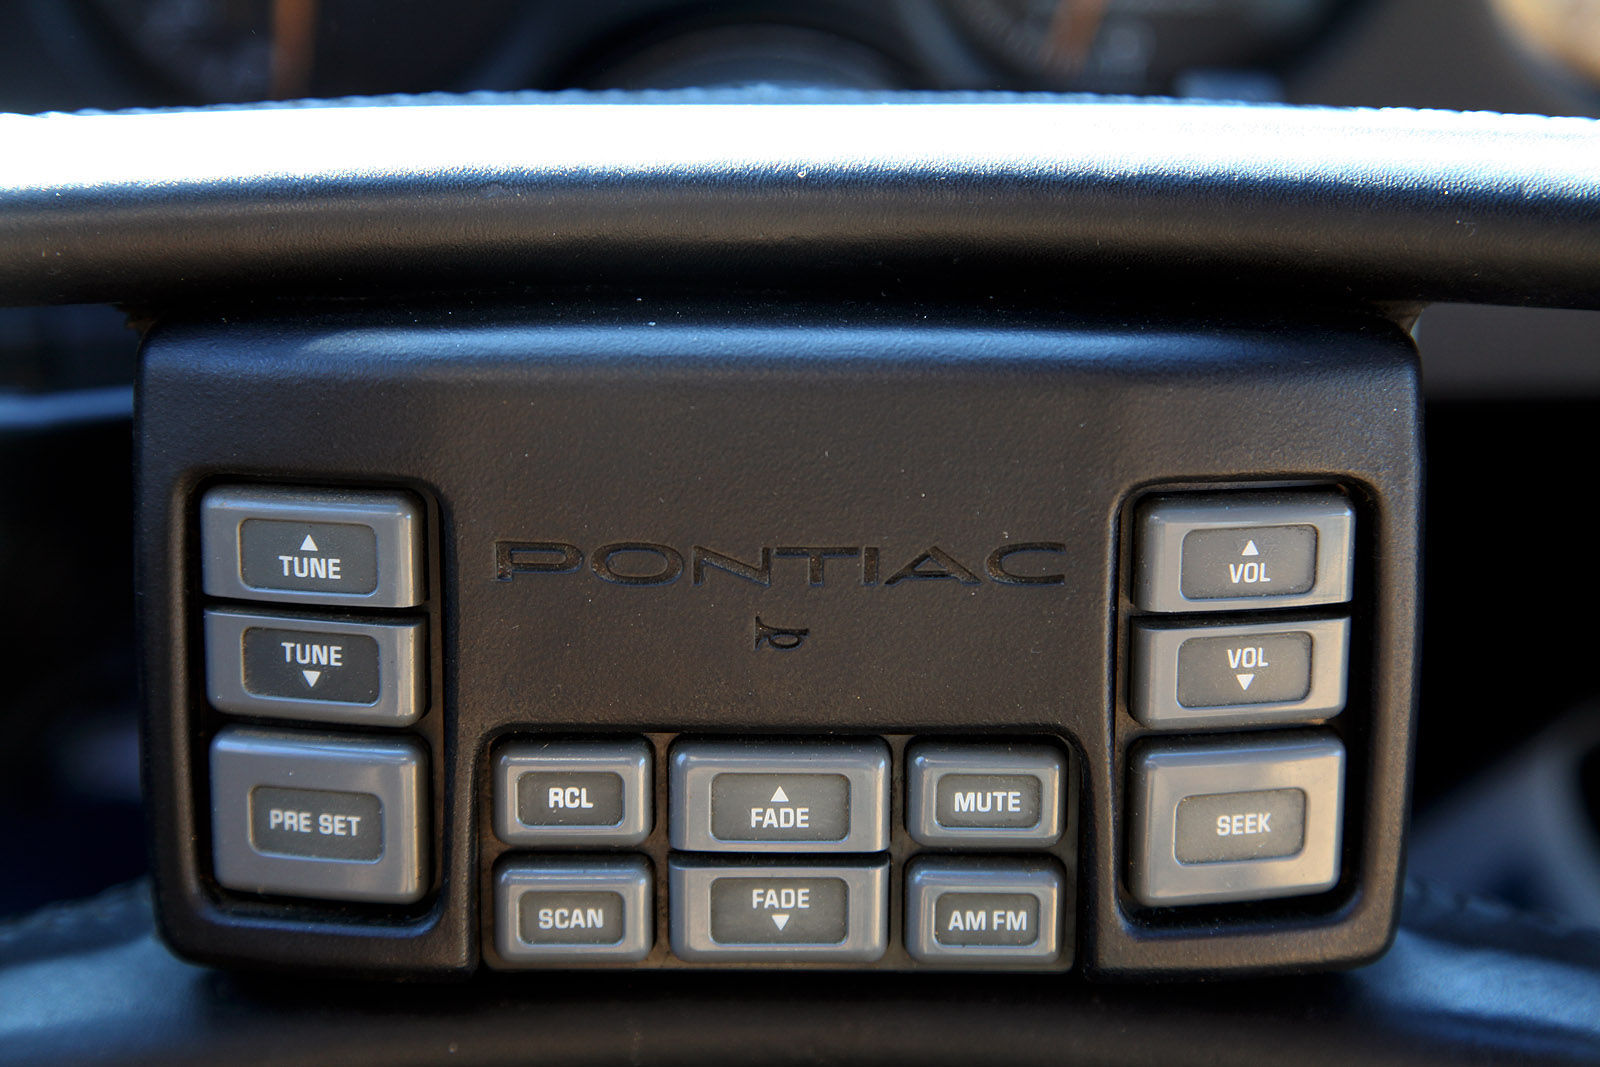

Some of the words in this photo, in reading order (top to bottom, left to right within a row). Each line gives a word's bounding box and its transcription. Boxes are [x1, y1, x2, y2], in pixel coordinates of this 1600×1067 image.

[278, 555, 342, 580] TUNE
[494, 540, 1067, 587] PONTIAC
[1229, 562, 1271, 584] VOL
[281, 642, 343, 667] TUNE
[1227, 647, 1270, 669] VOL
[547, 786, 595, 811] RCL
[952, 791, 1021, 813] MUTE
[268, 809, 312, 833] PRE
[317, 812, 362, 837] SET
[750, 807, 810, 829] FADE
[1215, 812, 1272, 836] SEEK
[751, 888, 811, 911] FADE
[537, 908, 605, 931] SCAN
[947, 910, 987, 931] AM
[992, 910, 1028, 931] FM
